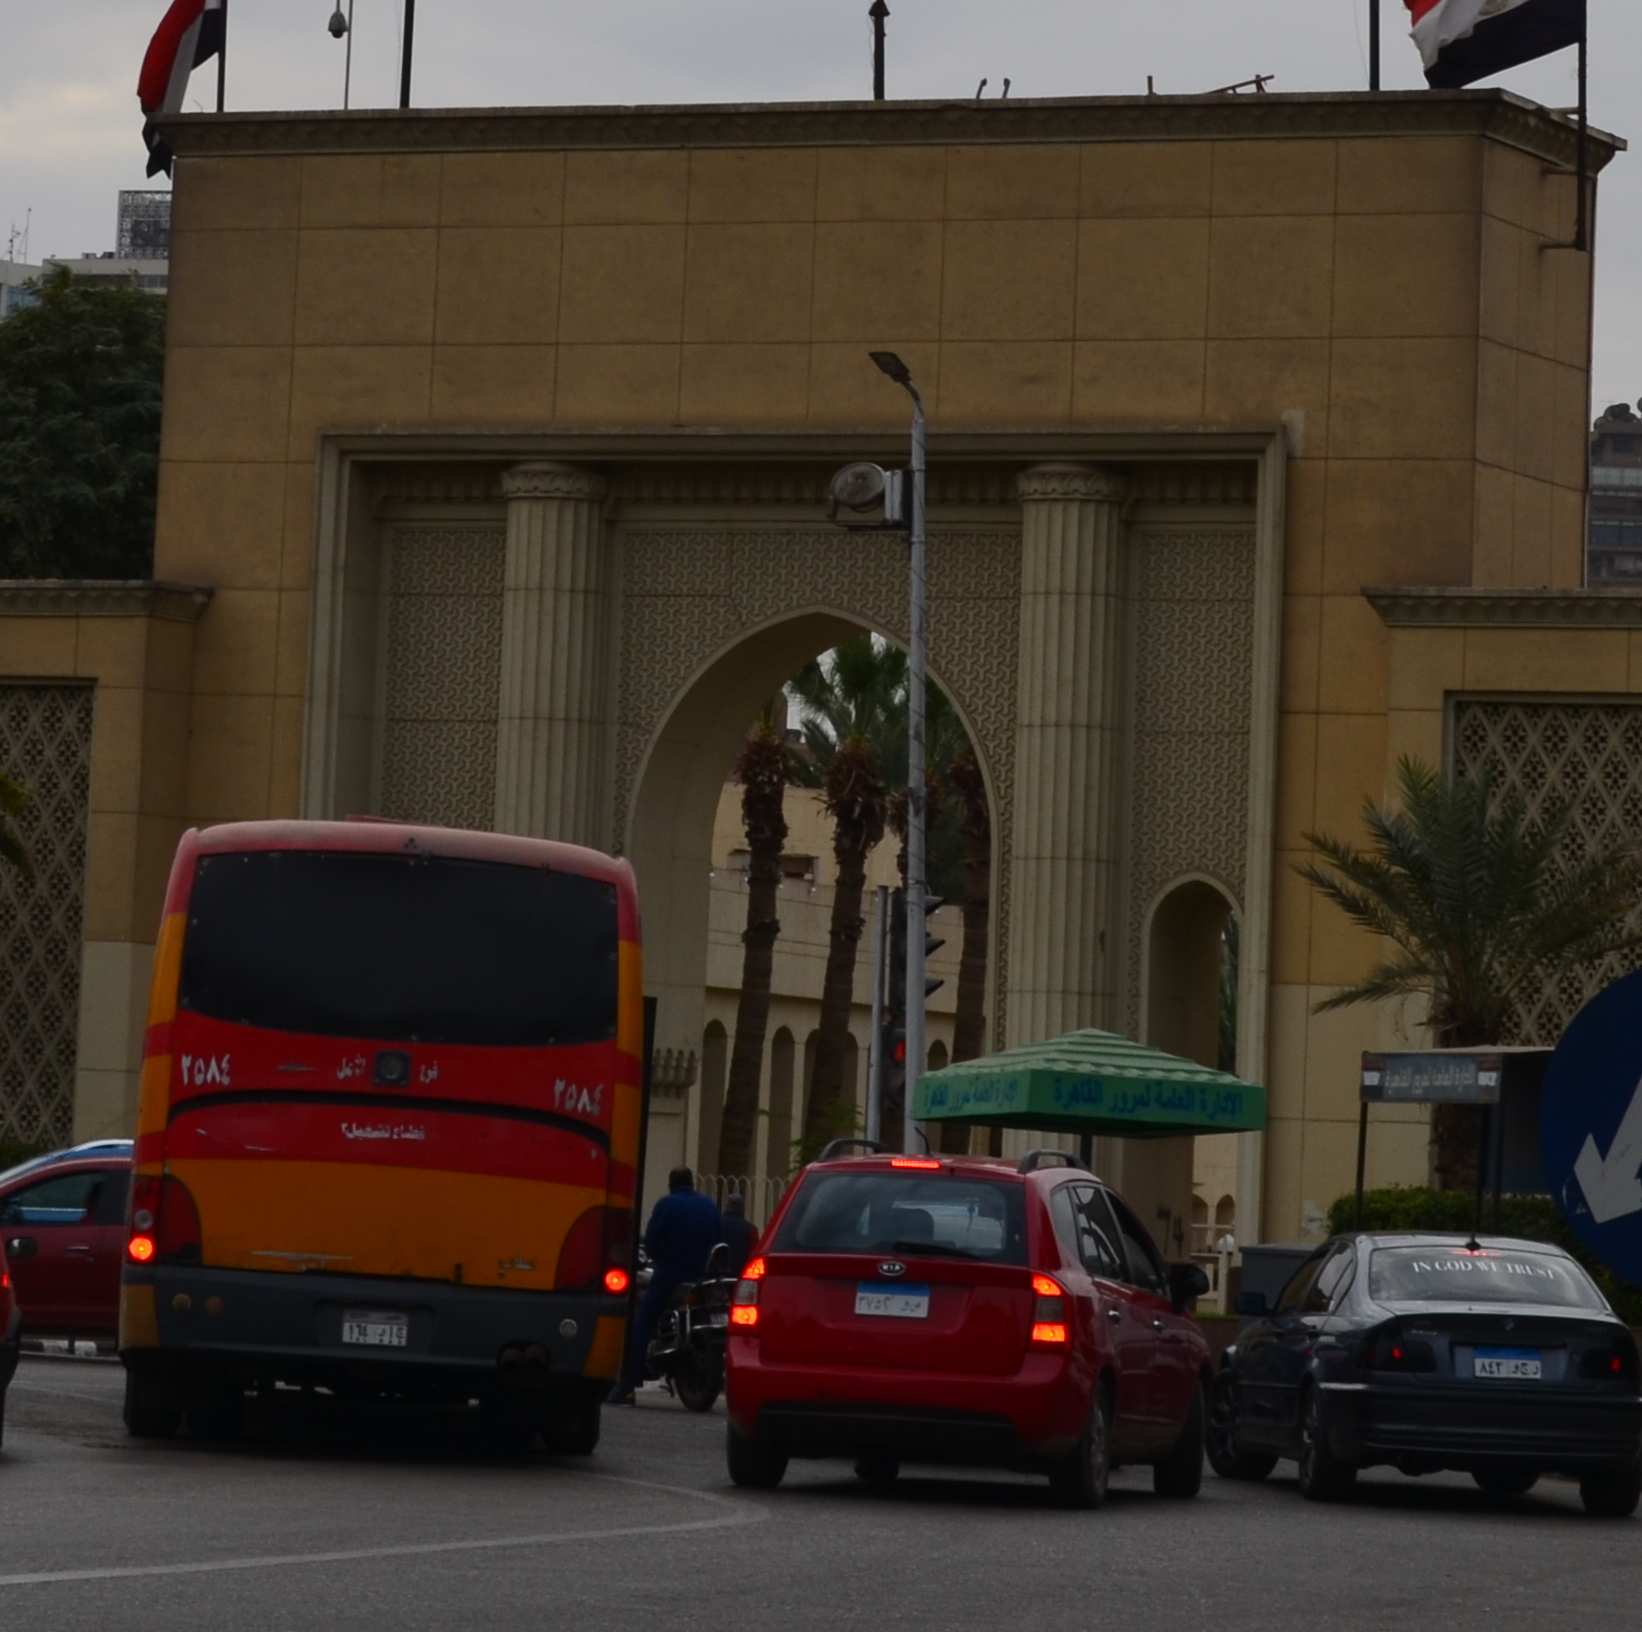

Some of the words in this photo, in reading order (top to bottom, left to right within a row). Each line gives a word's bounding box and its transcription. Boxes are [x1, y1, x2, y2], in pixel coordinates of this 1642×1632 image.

[1055, 1077, 1104, 1110] القاهرة
[1108, 1084, 1151, 1114] لمرور
[1412, 1260, 1432, 1273] IN
[1435, 1260, 1473, 1272] GOD
